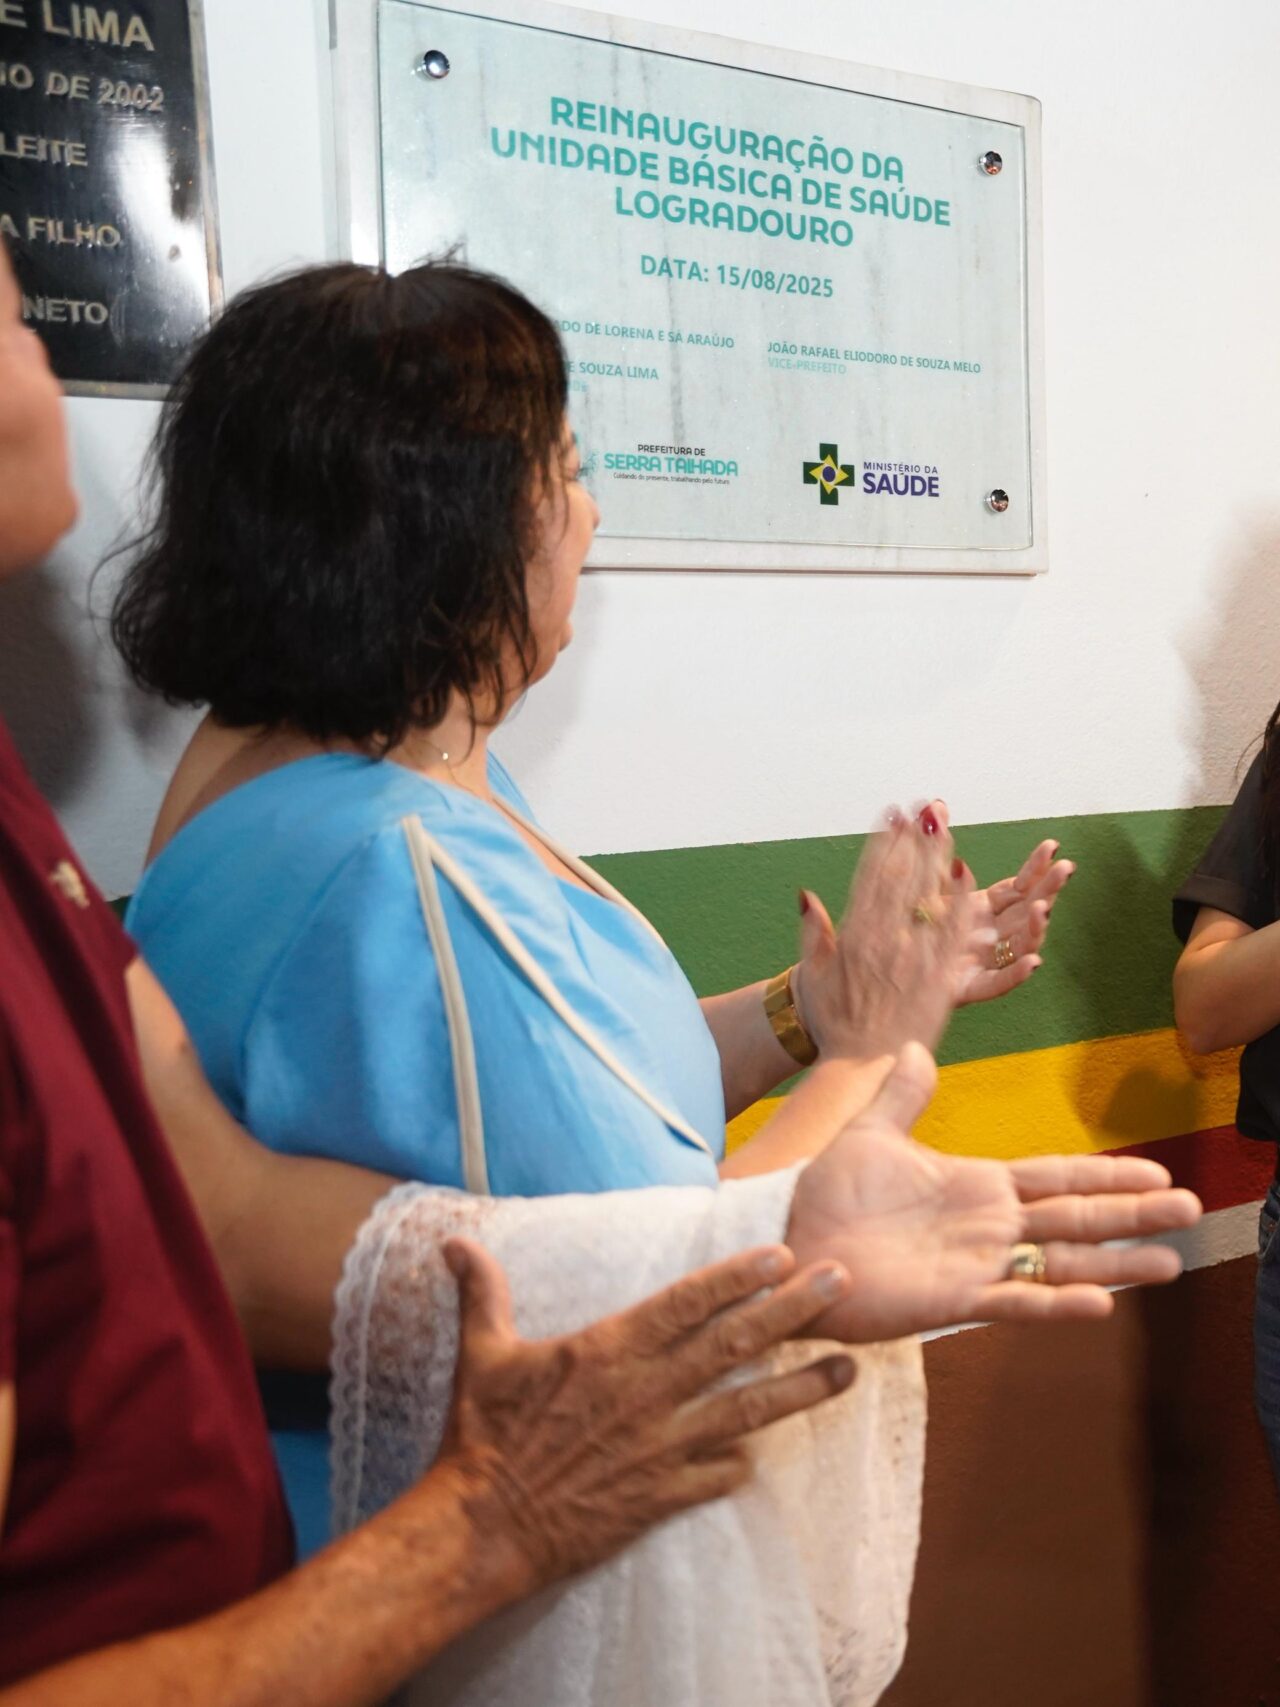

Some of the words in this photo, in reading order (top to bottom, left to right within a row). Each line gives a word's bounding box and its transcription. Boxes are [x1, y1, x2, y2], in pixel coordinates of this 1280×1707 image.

[0, 0, 27, 28] E
[42, 0, 155, 51] LIMA
[46, 71, 91, 99] DE
[98, 77, 164, 112] 2002
[0, 132, 88, 167] LEITE
[551, 96, 854, 175] REINAUGURAÇÃO
[862, 151, 904, 183] DA
[491, 127, 659, 181] UNIDADE
[669, 153, 792, 202] BÁSICA
[801, 178, 842, 210] DE
[850, 186, 951, 227] SAÚDE
[27, 216, 121, 248] FILHO
[615, 186, 854, 247] LOGRADOURO
[641, 255, 709, 282] DATA:
[717, 264, 834, 298] 15/08/2025
[22, 296, 109, 325] NETO
[585, 322, 601, 336] DE
[605, 324, 655, 341] LORENA
[657, 330, 665, 342] E
[687, 331, 735, 349] ARAÚJO
[579, 361, 623, 377] SOUZA
[627, 366, 660, 380] LIMA
[768, 340, 798, 355] JOÃO
[801, 345, 841, 360] RAFAEL
[844, 349, 897, 365] ELIODORO
[900, 355, 914, 367] DE
[916, 357, 951, 371] SOUZA
[953, 360, 982, 374] MELO
[768, 356, 848, 375] VICE-PREFEITO
[604, 453, 662, 473] SERRA
[664, 456, 739, 477] TALHADA
[637, 443, 693, 456] PREFEITURA
[694, 447, 706, 457] DE
[863, 461, 921, 474] MINISTÉRIO
[924, 465, 938, 475] DA
[862, 472, 940, 498] SAÚDE
